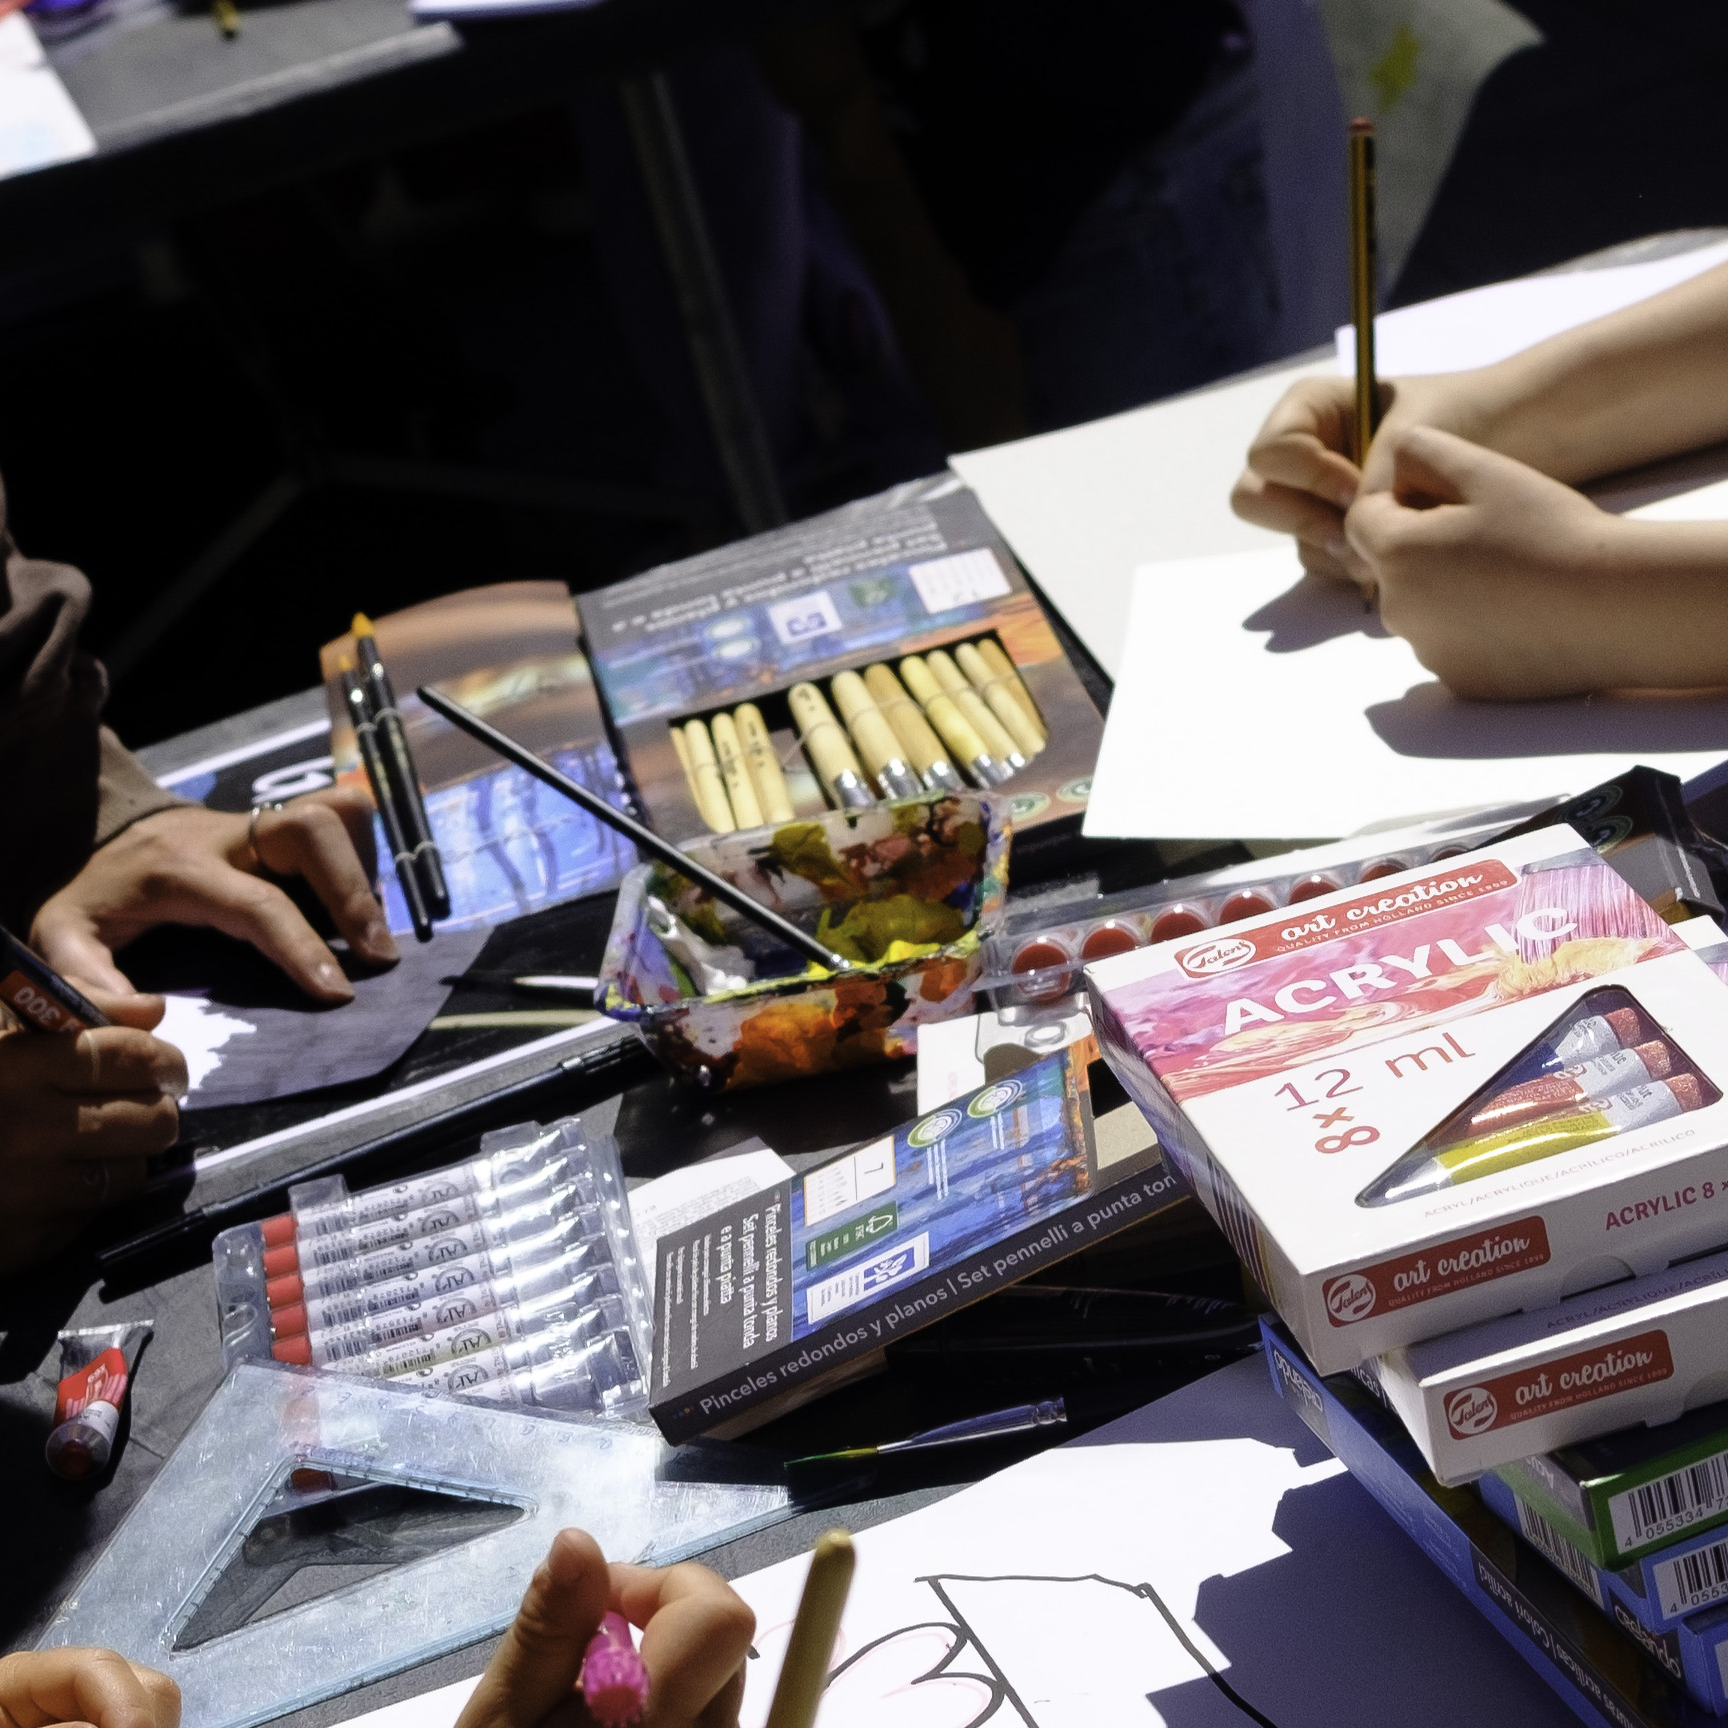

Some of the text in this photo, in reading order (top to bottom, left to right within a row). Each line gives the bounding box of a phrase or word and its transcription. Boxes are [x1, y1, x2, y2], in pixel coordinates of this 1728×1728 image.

[1281, 916, 1336, 942] art
[1346, 872, 1484, 920] creation
[1335, 920, 1370, 937] FROM
[1374, 904, 1433, 927] HOLLAND
[1224, 907, 1578, 1036] ACRYLIC
[1274, 1032, 1476, 1112] 12 ml
[742, 1213, 759, 1234] Set
[1604, 1185, 1698, 1232] ACRYLIC
[1702, 1181, 1716, 1201] 8
[765, 1246, 783, 1299] redondos
[1393, 1259, 1432, 1291] art
[1437, 1236, 1530, 1281] creation
[700, 1172, 1179, 1415] Pinceles redondos y planos Set pennelli a punta ton
[743, 1313, 760, 1349] tonda
[765, 1308, 783, 1342] planos
[1515, 1373, 1553, 1405] art
[1559, 1347, 1653, 1391] creation
[1624, 1534, 1635, 1549] 4
[1645, 1505, 1704, 1539] 055334
[1669, 1600, 1679, 1614] 4
